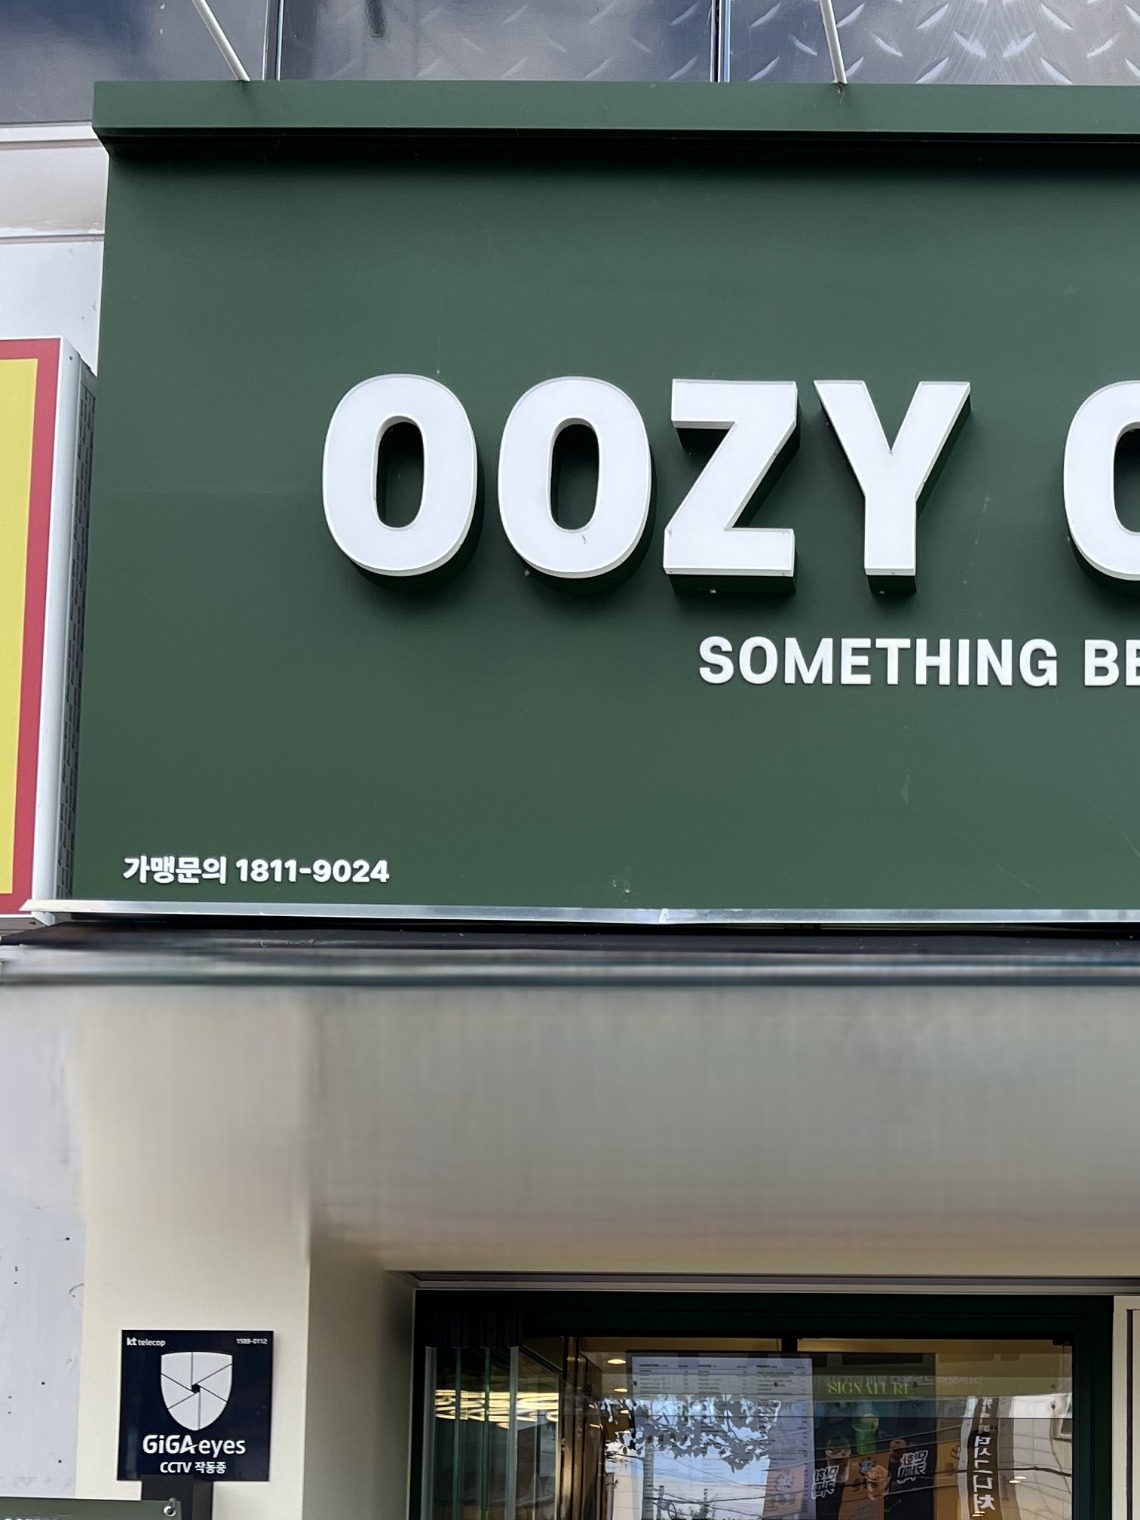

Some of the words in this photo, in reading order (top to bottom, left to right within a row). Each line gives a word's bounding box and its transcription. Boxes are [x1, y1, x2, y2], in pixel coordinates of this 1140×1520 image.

[322, 374, 970, 592] OOZY
[698, 636, 1058, 688] SOMETHING
[123, 854, 228, 886] 가맹문의
[235, 858, 390, 885] 1811-9024
[126, 1337, 138, 1346] kt
[160, 1462, 192, 1474] CCTV
[194, 1461, 227, 1474] 작동중
